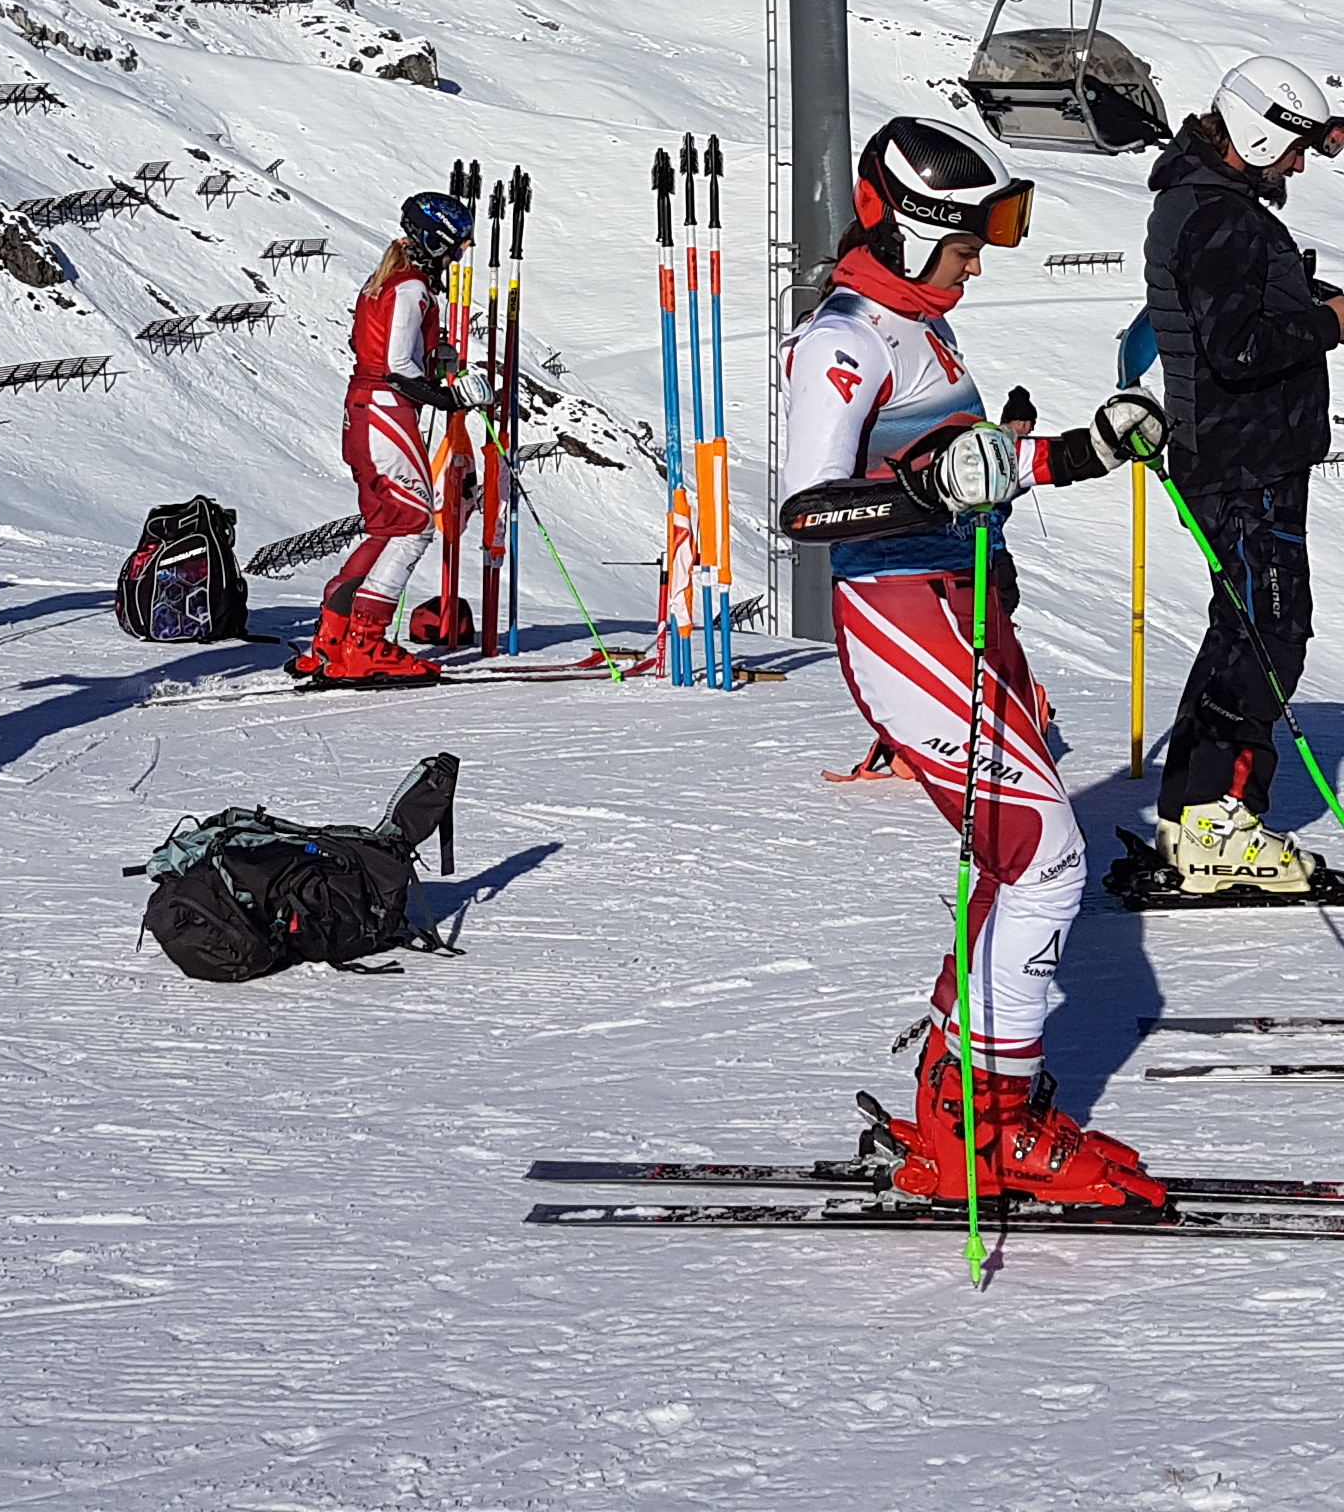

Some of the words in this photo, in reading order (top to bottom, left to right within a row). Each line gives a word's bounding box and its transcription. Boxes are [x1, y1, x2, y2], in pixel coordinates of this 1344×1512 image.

[1280, 111, 1313, 129] POC
[901, 195, 962, 224] bollé
[826, 349, 863, 404] A1
[804, 503, 893, 527] DAINESE
[1189, 864, 1279, 878] HEAD
[997, 1168, 1054, 1184] ATOMIC
